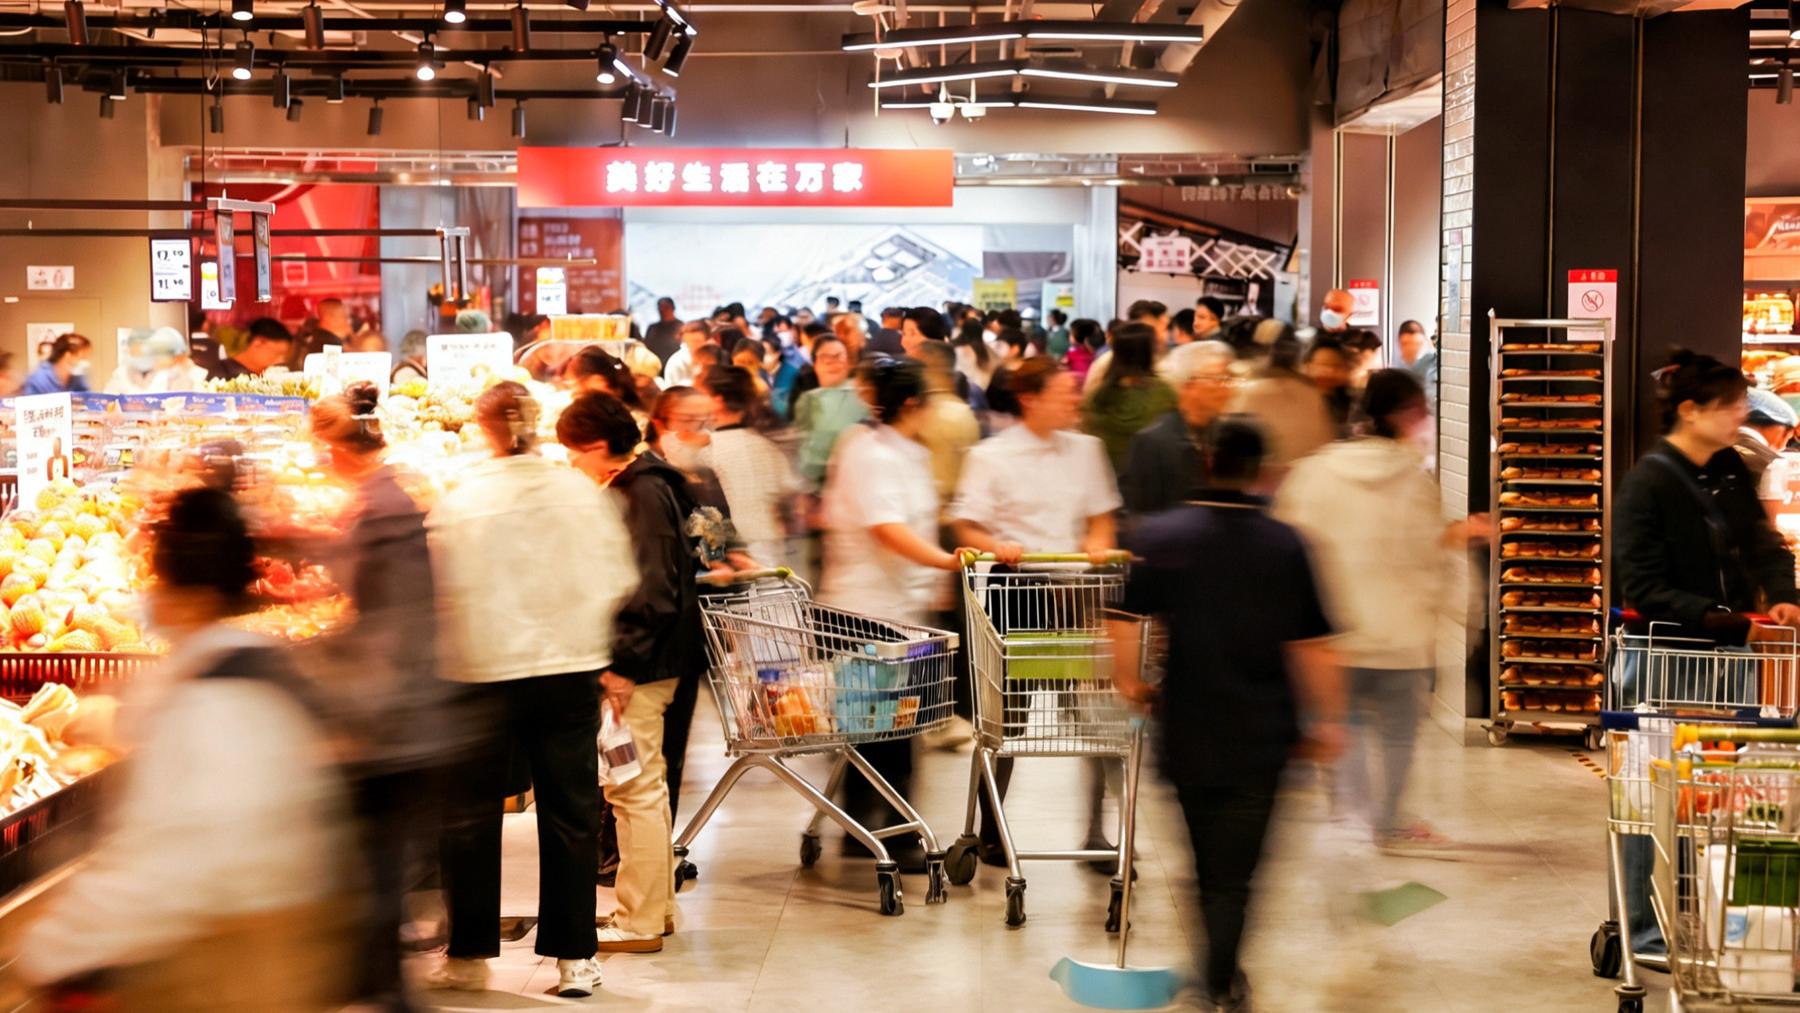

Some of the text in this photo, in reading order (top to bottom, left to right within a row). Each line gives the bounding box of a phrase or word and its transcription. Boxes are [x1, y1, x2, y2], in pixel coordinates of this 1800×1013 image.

[606, 160, 863, 193] 美好生活在万家
